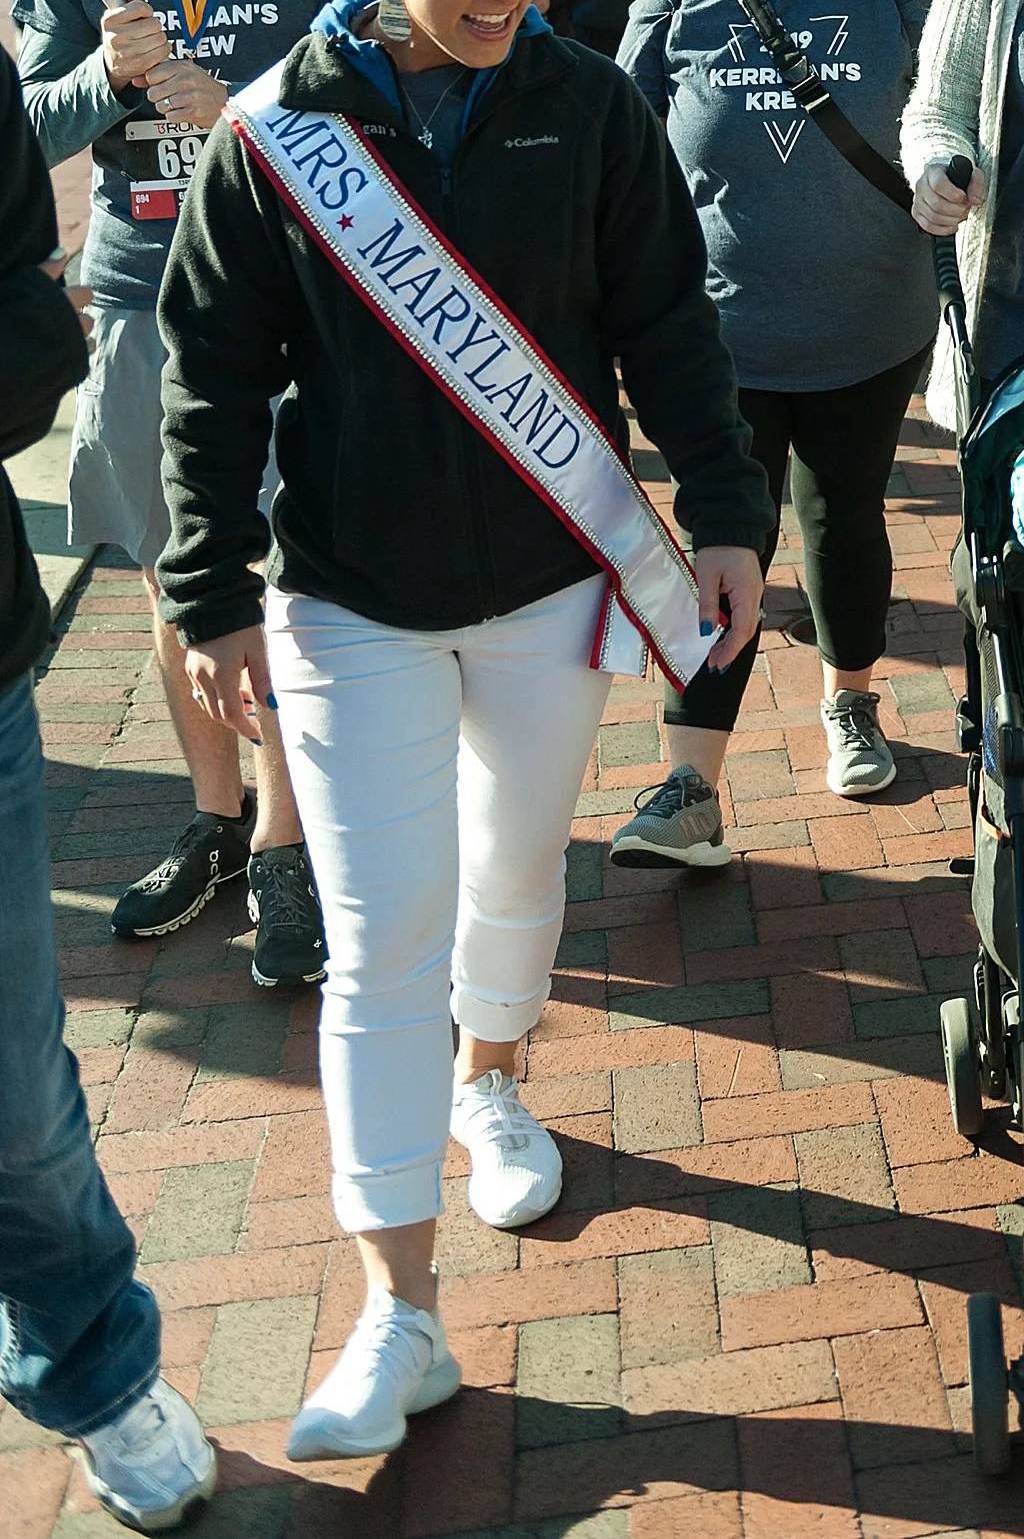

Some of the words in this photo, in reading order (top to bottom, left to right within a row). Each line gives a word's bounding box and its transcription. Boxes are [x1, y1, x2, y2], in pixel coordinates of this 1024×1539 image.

[745, 90, 799, 111] KRE
[362, 124, 397, 138] gan's
[514, 135, 560, 147] Columbia
[157, 136, 204, 179] 69
[135, 205, 140, 214] 1
[266, 110, 369, 210] MRS
[356, 217, 582, 470] MARYLAND
